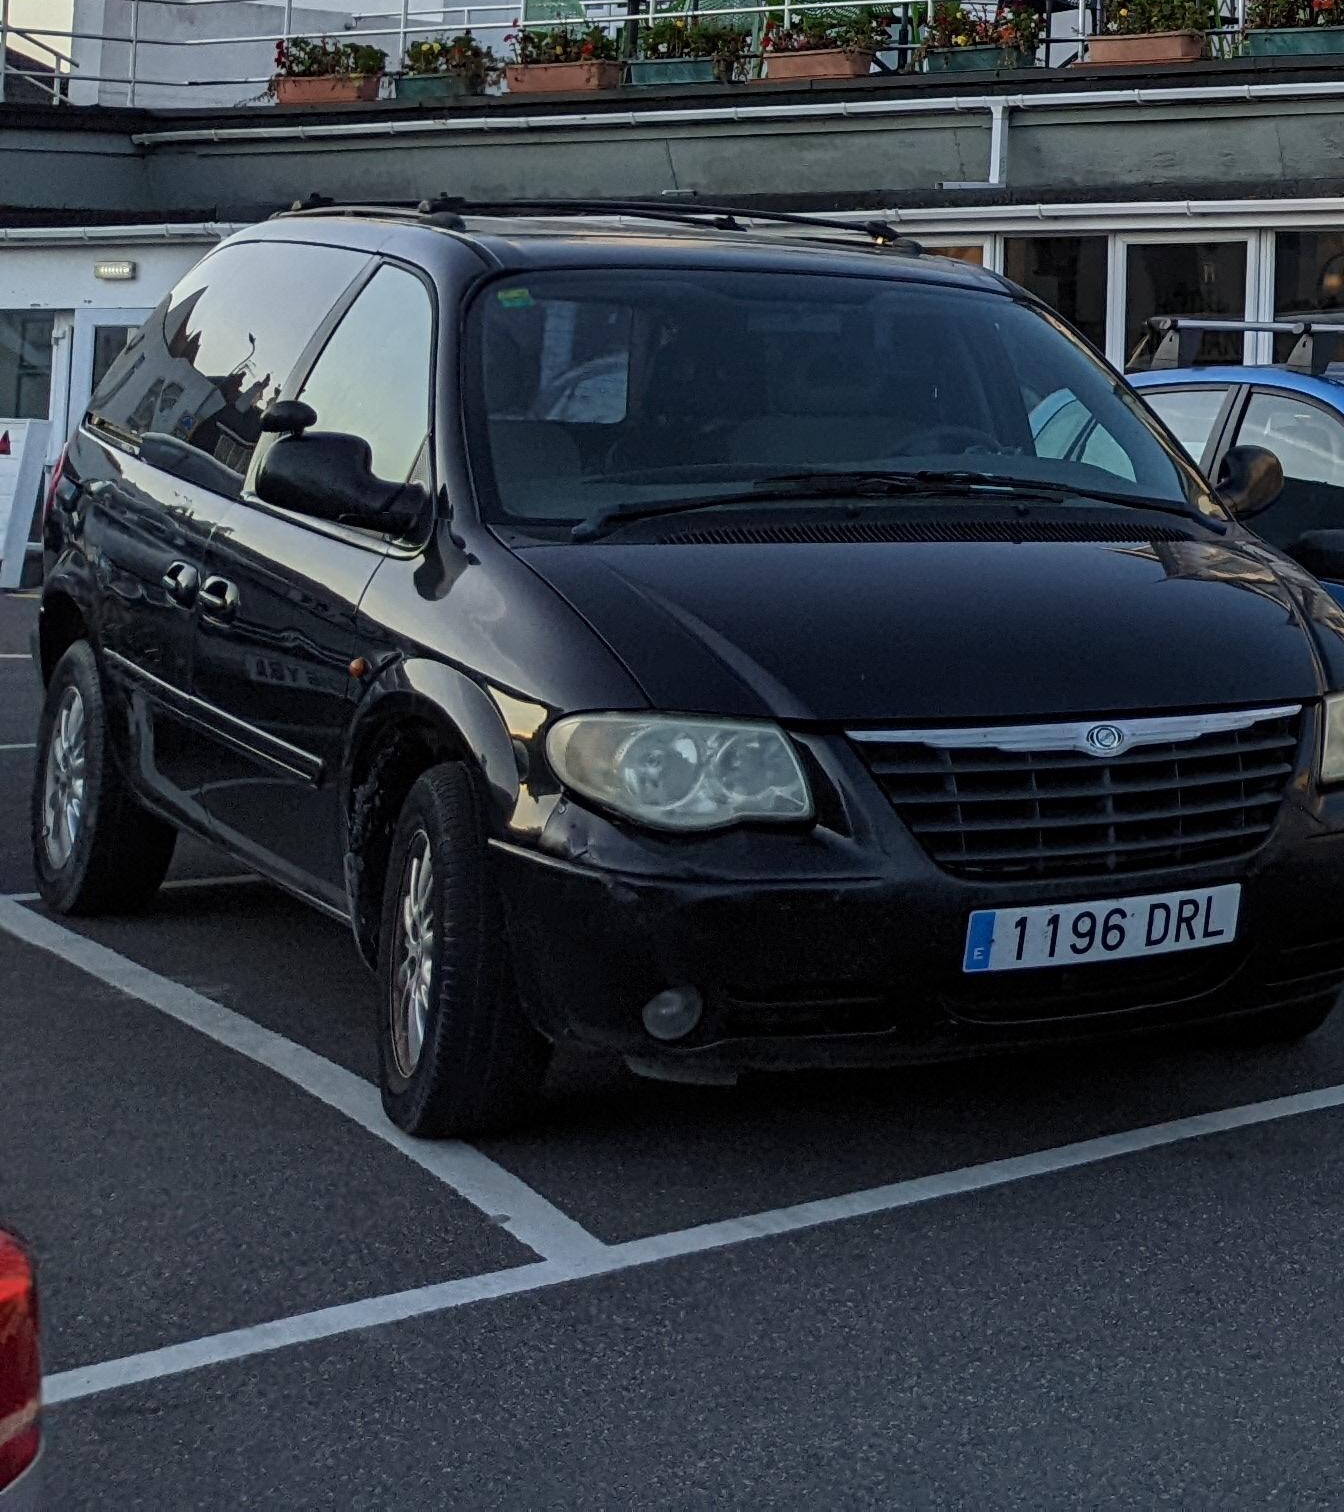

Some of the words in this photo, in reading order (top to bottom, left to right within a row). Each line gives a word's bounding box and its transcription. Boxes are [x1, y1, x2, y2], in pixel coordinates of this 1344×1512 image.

[1014, 908, 1127, 960] 1196
[1145, 896, 1225, 948] DRL
[973, 947, 983, 960] E
